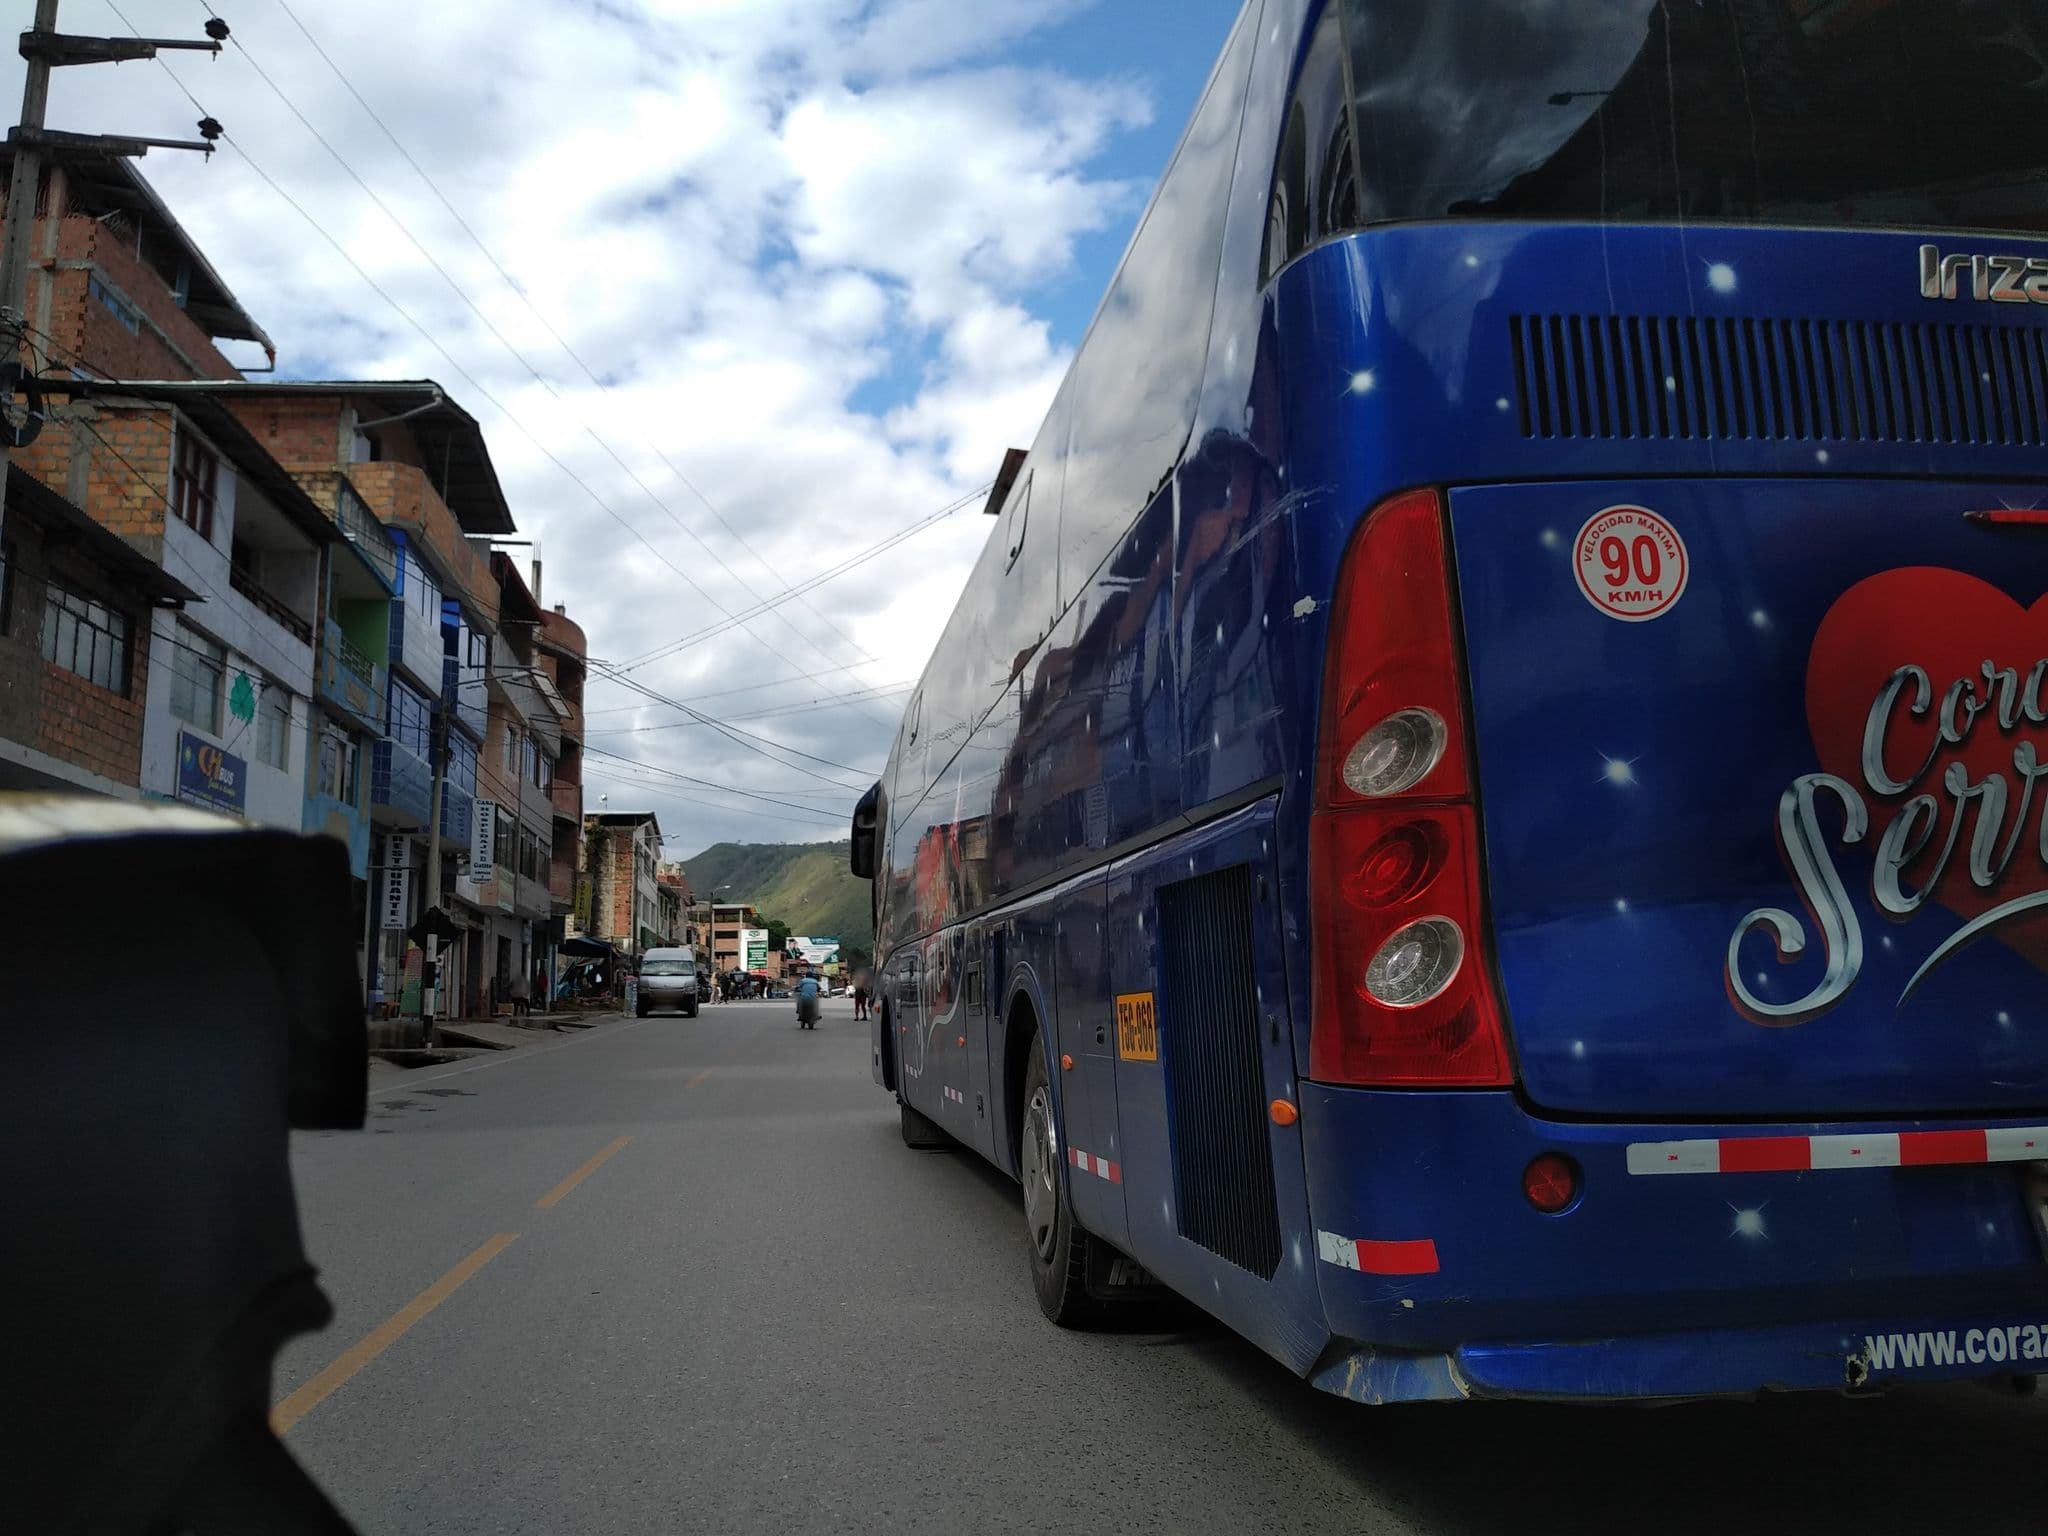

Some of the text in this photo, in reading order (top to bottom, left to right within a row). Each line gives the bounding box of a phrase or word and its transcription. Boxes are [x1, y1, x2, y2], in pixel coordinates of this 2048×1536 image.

[1584, 515, 1676, 562] VELOCIDAD MAXIMA
[1600, 535, 1661, 587] 90
[1608, 590, 1663, 602] KM/H
[219, 767, 235, 786] BUS
[480, 807, 489, 855] HOSPEDAJE
[1866, 1325, 2048, 1370] www.cora
